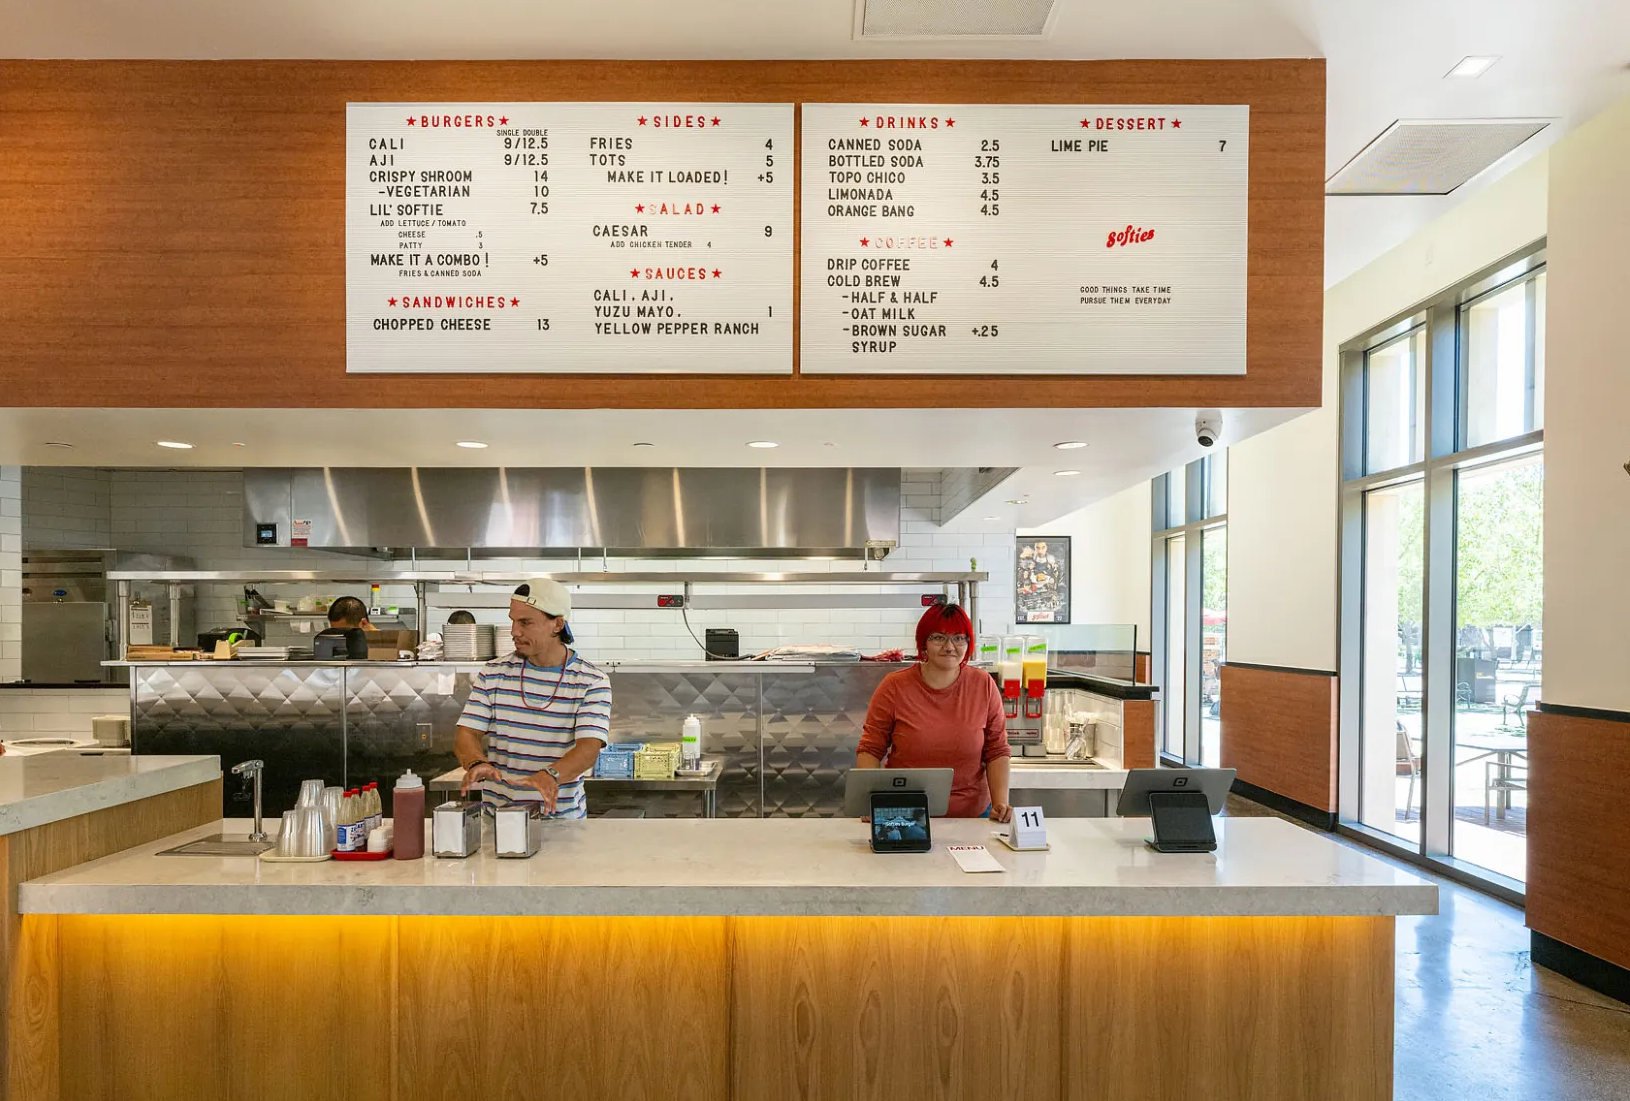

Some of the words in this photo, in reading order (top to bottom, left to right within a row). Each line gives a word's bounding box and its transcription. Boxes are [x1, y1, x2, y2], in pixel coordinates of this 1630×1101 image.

[421, 116, 495, 127] BURGERS
[654, 116, 706, 127] SIDES
[877, 117, 938, 128] DRINKS
[1096, 118, 1165, 130] DESSERT
[369, 139, 404, 149] CALI
[590, 138, 632, 149] FRIES
[766, 139, 773, 150] 4
[829, 139, 881, 150] CANNED
[889, 139, 922, 150] SODA
[982, 140, 999, 152] 2.5
[1052, 140, 1082, 152] LIME
[1089, 140, 1108, 152] PIE
[1219, 140, 1226, 152] 7
[370, 155, 394, 166] AJI
[590, 155, 625, 166] TOTS
[766, 156, 773, 166] 5
[829, 156, 884, 167] BOTTLED
[891, 156, 923, 167] SODA
[975, 157, 999, 168] 3.75
[370, 172, 415, 182] CRISPY
[421, 172, 472, 182] SHROOM
[534, 171, 548, 182] 14
[608, 172, 644, 183] MAKE
[651, 172, 663, 183] IT
[669, 170, 727, 184] LOADED!
[758, 172, 773, 183] +5
[829, 172, 862, 183] TOPO
[867, 172, 905, 183] CHICO
[982, 173, 999, 184] 3.5
[534, 186, 549, 197] 10
[829, 189, 893, 200] LIMONADA
[981, 190, 999, 201] 4.5
[397, 204, 443, 215] SOFTIE
[530, 203, 548, 214] 7.5
[649, 204, 704, 214] SALAD
[828, 205, 876, 216] ORANGE
[882, 205, 914, 216] BANG
[981, 205, 999, 216] 4.5
[593, 226, 648, 237] CAESAR
[765, 226, 772, 237] 9
[875, 237, 938, 248] COFFEE
[371, 254, 403, 265] MAKE
[410, 254, 420, 265] IT
[425, 254, 433, 265] A
[533, 255, 548, 266] +5
[828, 259, 856, 270] DRIP
[862, 259, 910, 270] COFFEE
[991, 260, 998, 270] 4
[646, 268, 706, 279] SAUCES
[828, 276, 860, 287] COLD
[866, 276, 900, 287] BREW
[980, 276, 998, 287] 4.5
[403, 297, 505, 308] SANDWICHES
[904, 292, 938, 303] HALF
[595, 306, 630, 317] YUZU
[769, 306, 772, 317] 1
[882, 308, 915, 319] MILK
[374, 319, 434, 330] CHOPPED
[441, 319, 491, 330] CHEESE
[537, 319, 550, 330] 13
[595, 323, 651, 334] YELLOW
[658, 323, 708, 334] PEPPER
[714, 323, 759, 334] RANCH
[903, 325, 946, 336] SUGAR
[852, 341, 896, 353] SYRUP
[1022, 812, 1039, 827] 11
